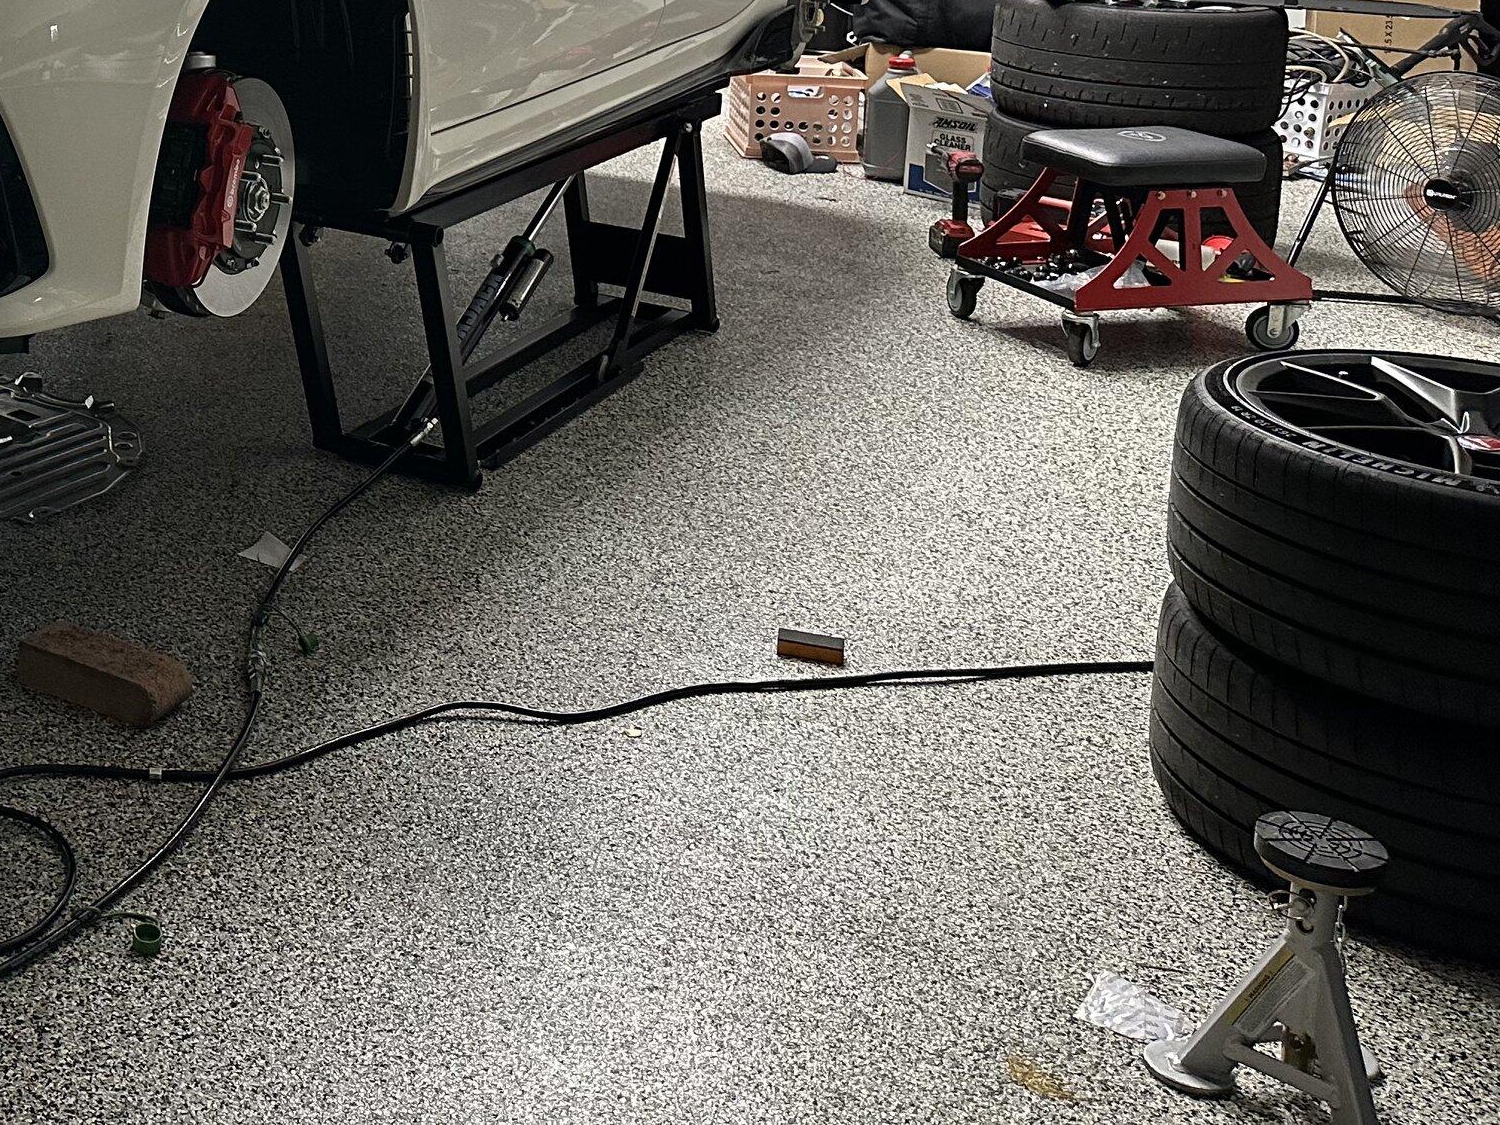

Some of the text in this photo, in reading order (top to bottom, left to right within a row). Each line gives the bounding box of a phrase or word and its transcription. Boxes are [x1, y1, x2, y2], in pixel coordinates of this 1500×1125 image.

[932, 117, 978, 132] AMSOIL
[933, 139, 971, 152] CLEANER
[940, 133, 967, 144] GLASS
[1301, 440, 1463, 487] MICHELIN
